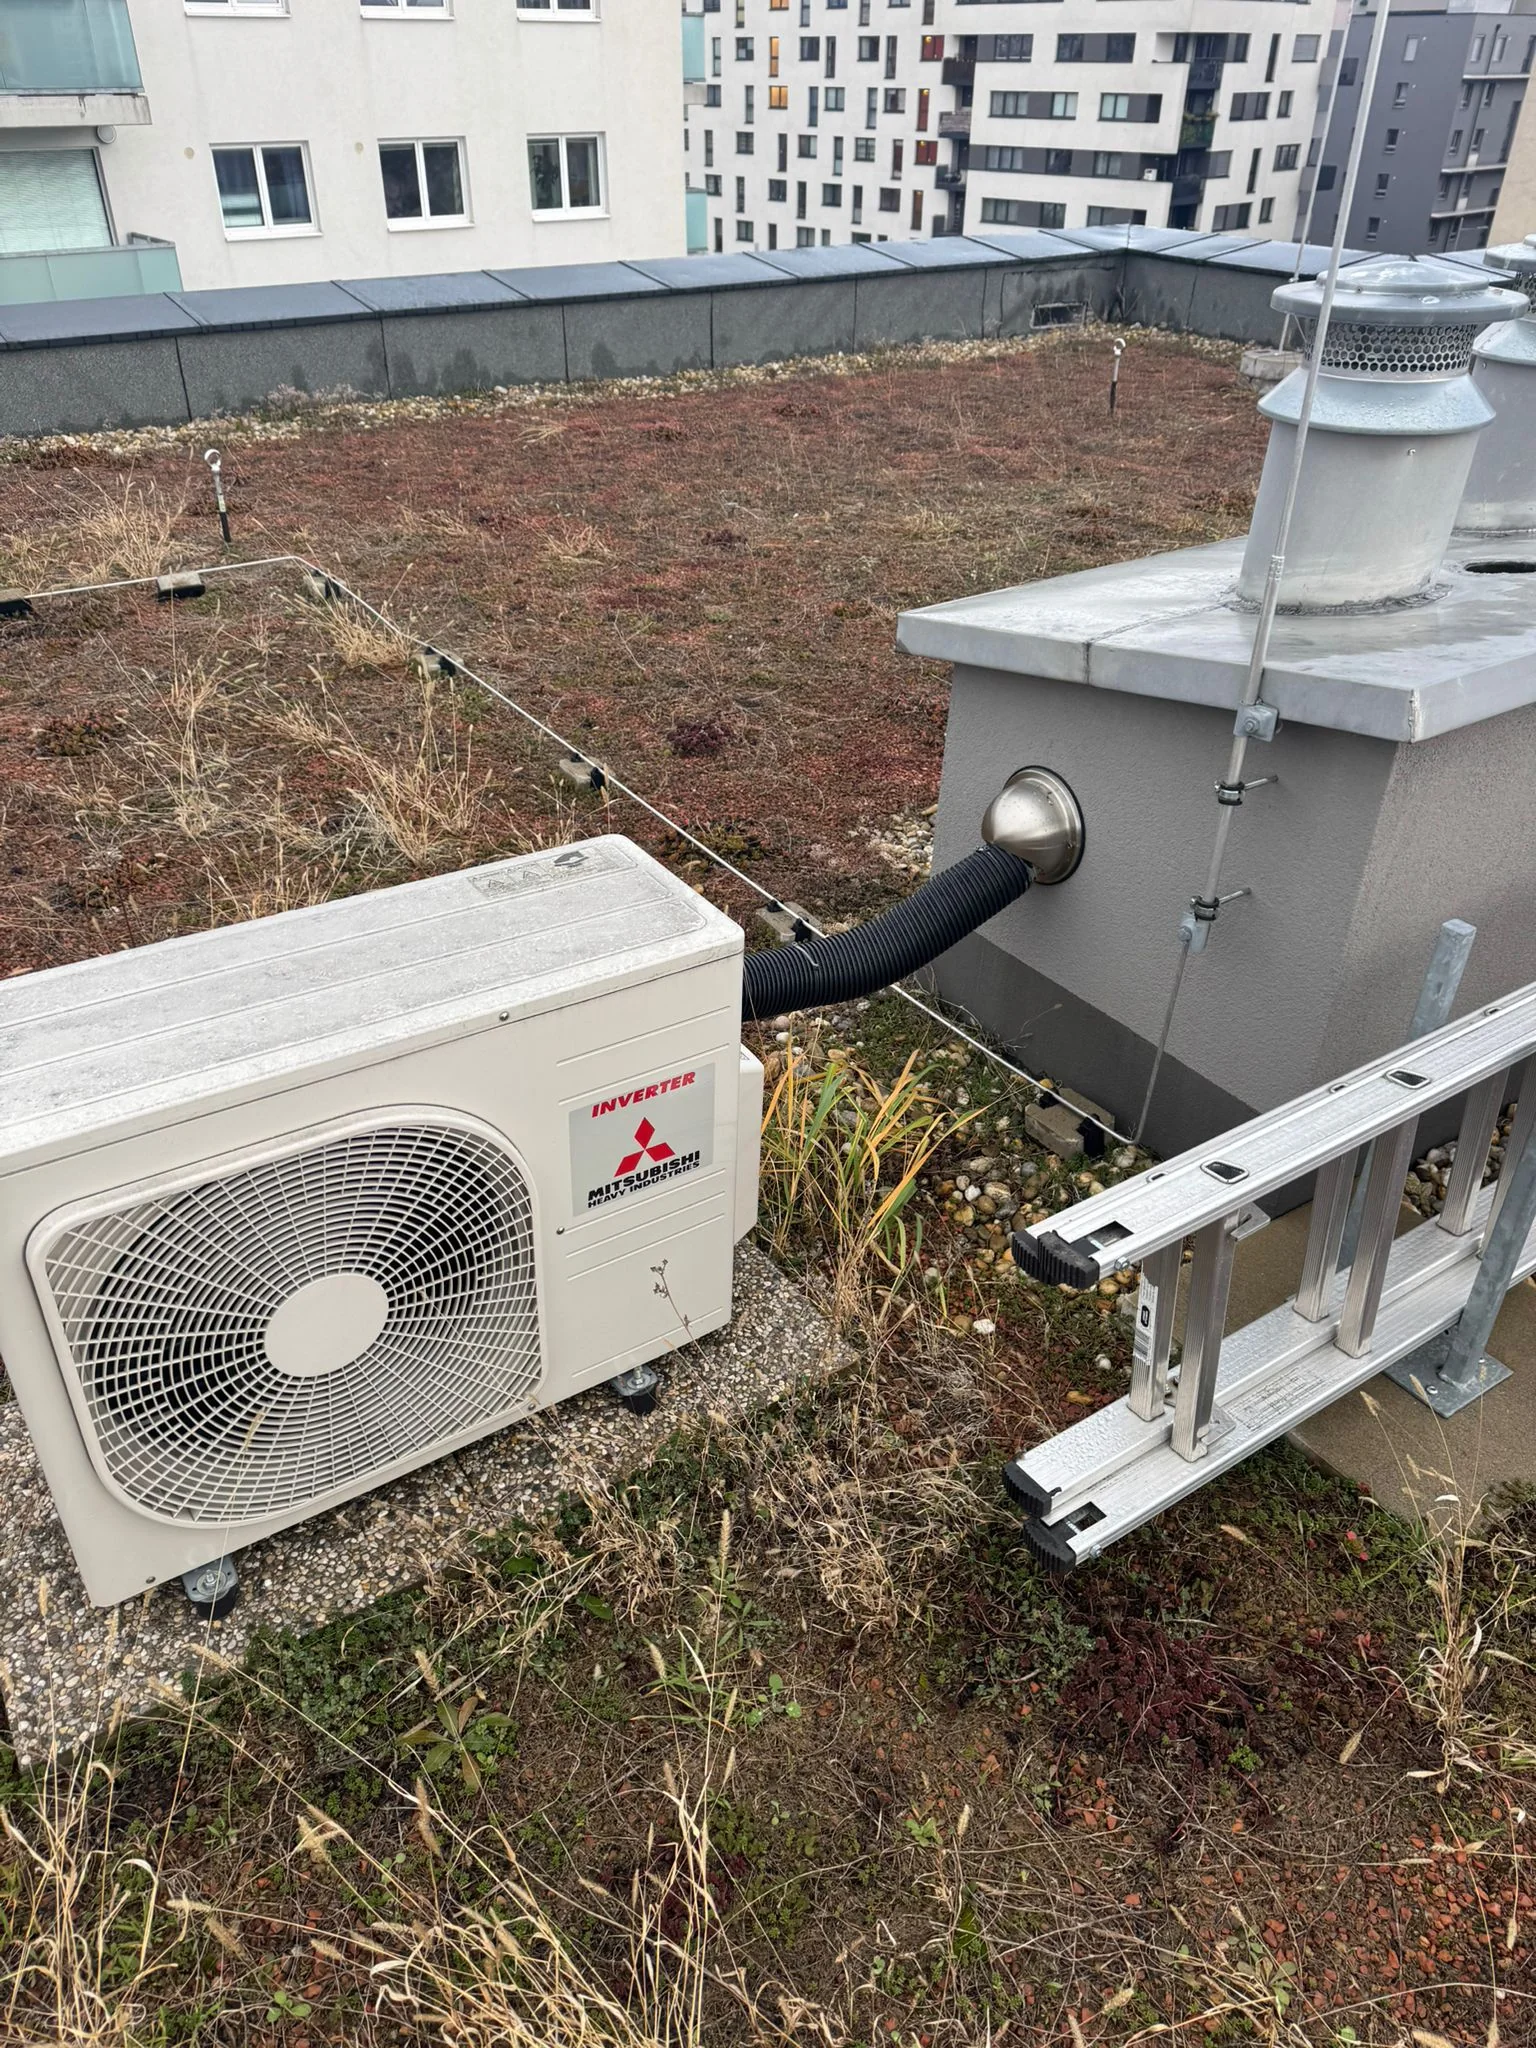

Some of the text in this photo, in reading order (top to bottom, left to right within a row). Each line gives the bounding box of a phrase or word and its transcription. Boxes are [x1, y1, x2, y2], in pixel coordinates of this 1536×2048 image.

[592, 1072, 695, 1118] INVERTER
[588, 1150, 700, 1201] MITSUBISHI
[588, 1161, 700, 1208] HEAVY INDUSTRIES
